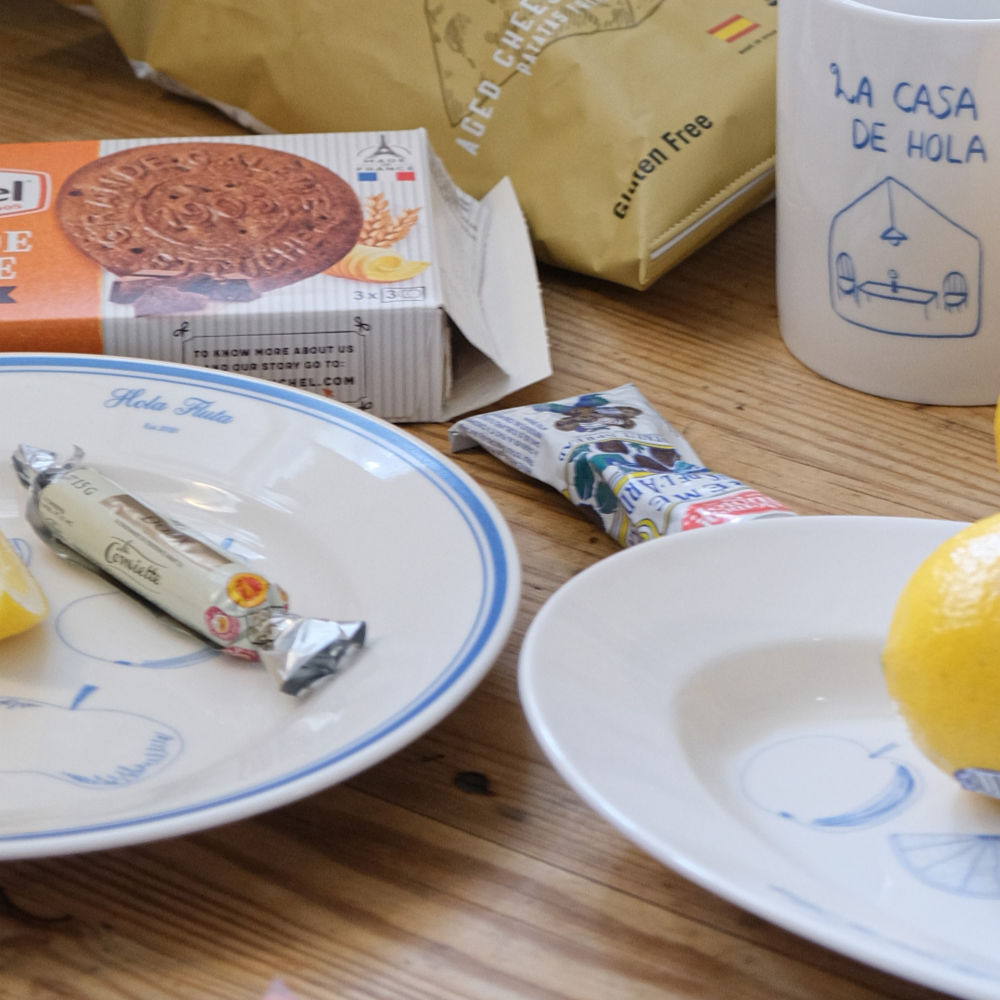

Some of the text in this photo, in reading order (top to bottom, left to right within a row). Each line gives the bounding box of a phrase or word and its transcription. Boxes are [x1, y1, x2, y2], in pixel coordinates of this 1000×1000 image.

[515, 8, 569, 76] PATATAS
[828, 62, 979, 122] LA CASA
[455, 79, 503, 157] AGED
[660, 113, 714, 153] Free
[851, 118, 988, 164] DE HOLA
[353, 290, 365, 301] 3
[385, 290, 397, 300] 3
[193, 344, 354, 359] TO KNOW MORE ABOUT US
[261, 361, 300, 371] STORY
[303, 360, 321, 369] GO
[103, 387, 235, 424] Hola Fluta
